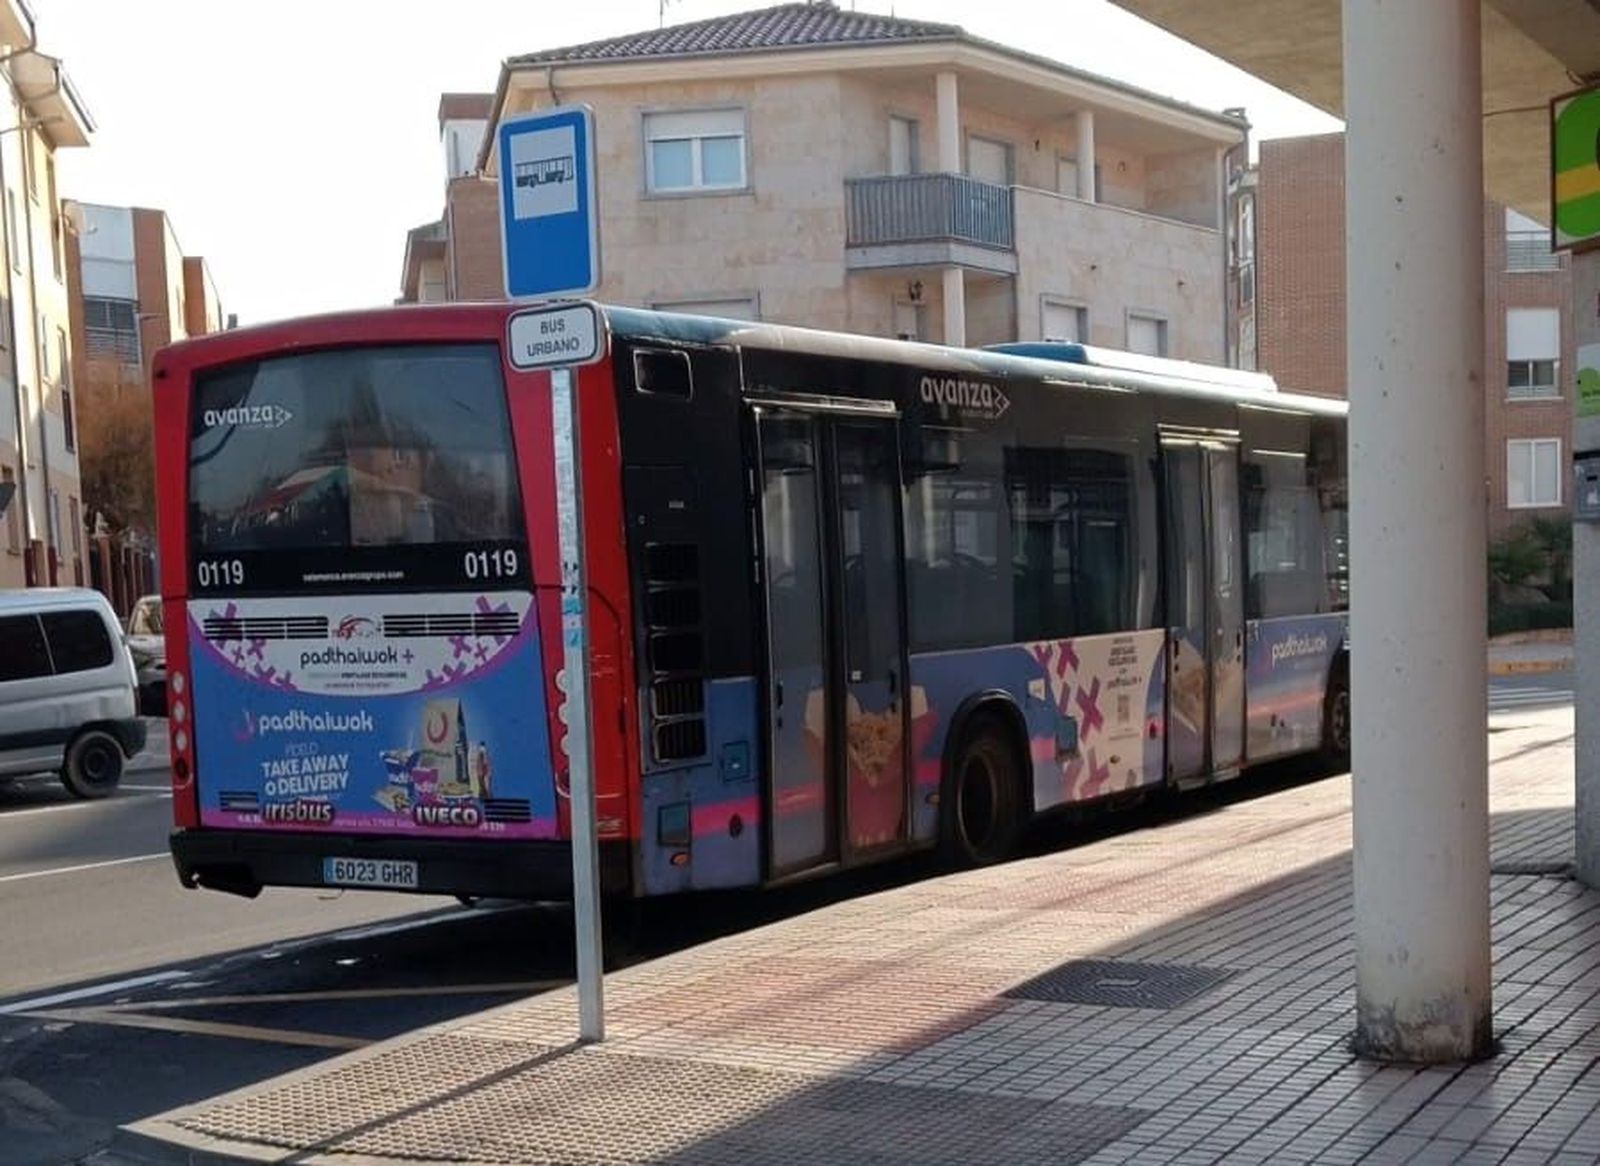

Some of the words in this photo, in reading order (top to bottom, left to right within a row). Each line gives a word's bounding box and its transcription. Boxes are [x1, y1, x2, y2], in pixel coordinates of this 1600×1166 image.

[540, 319, 565, 335] BUS
[526, 337, 580, 357] URBANO
[921, 376, 993, 409] avanza
[204, 405, 273, 427] avanza
[198, 559, 244, 587] 0119
[464, 549, 518, 579] 0119
[300, 645, 398, 670] padthaiwok
[259, 709, 374, 736] padthaiwok
[260, 758, 300, 779] TAKE
[301, 753, 350, 775] AWAY
[279, 769, 350, 795] DELIVERY
[415, 805, 479, 826] IVECO
[335, 861, 377, 882] 6023
[382, 863, 414, 885] GHR
